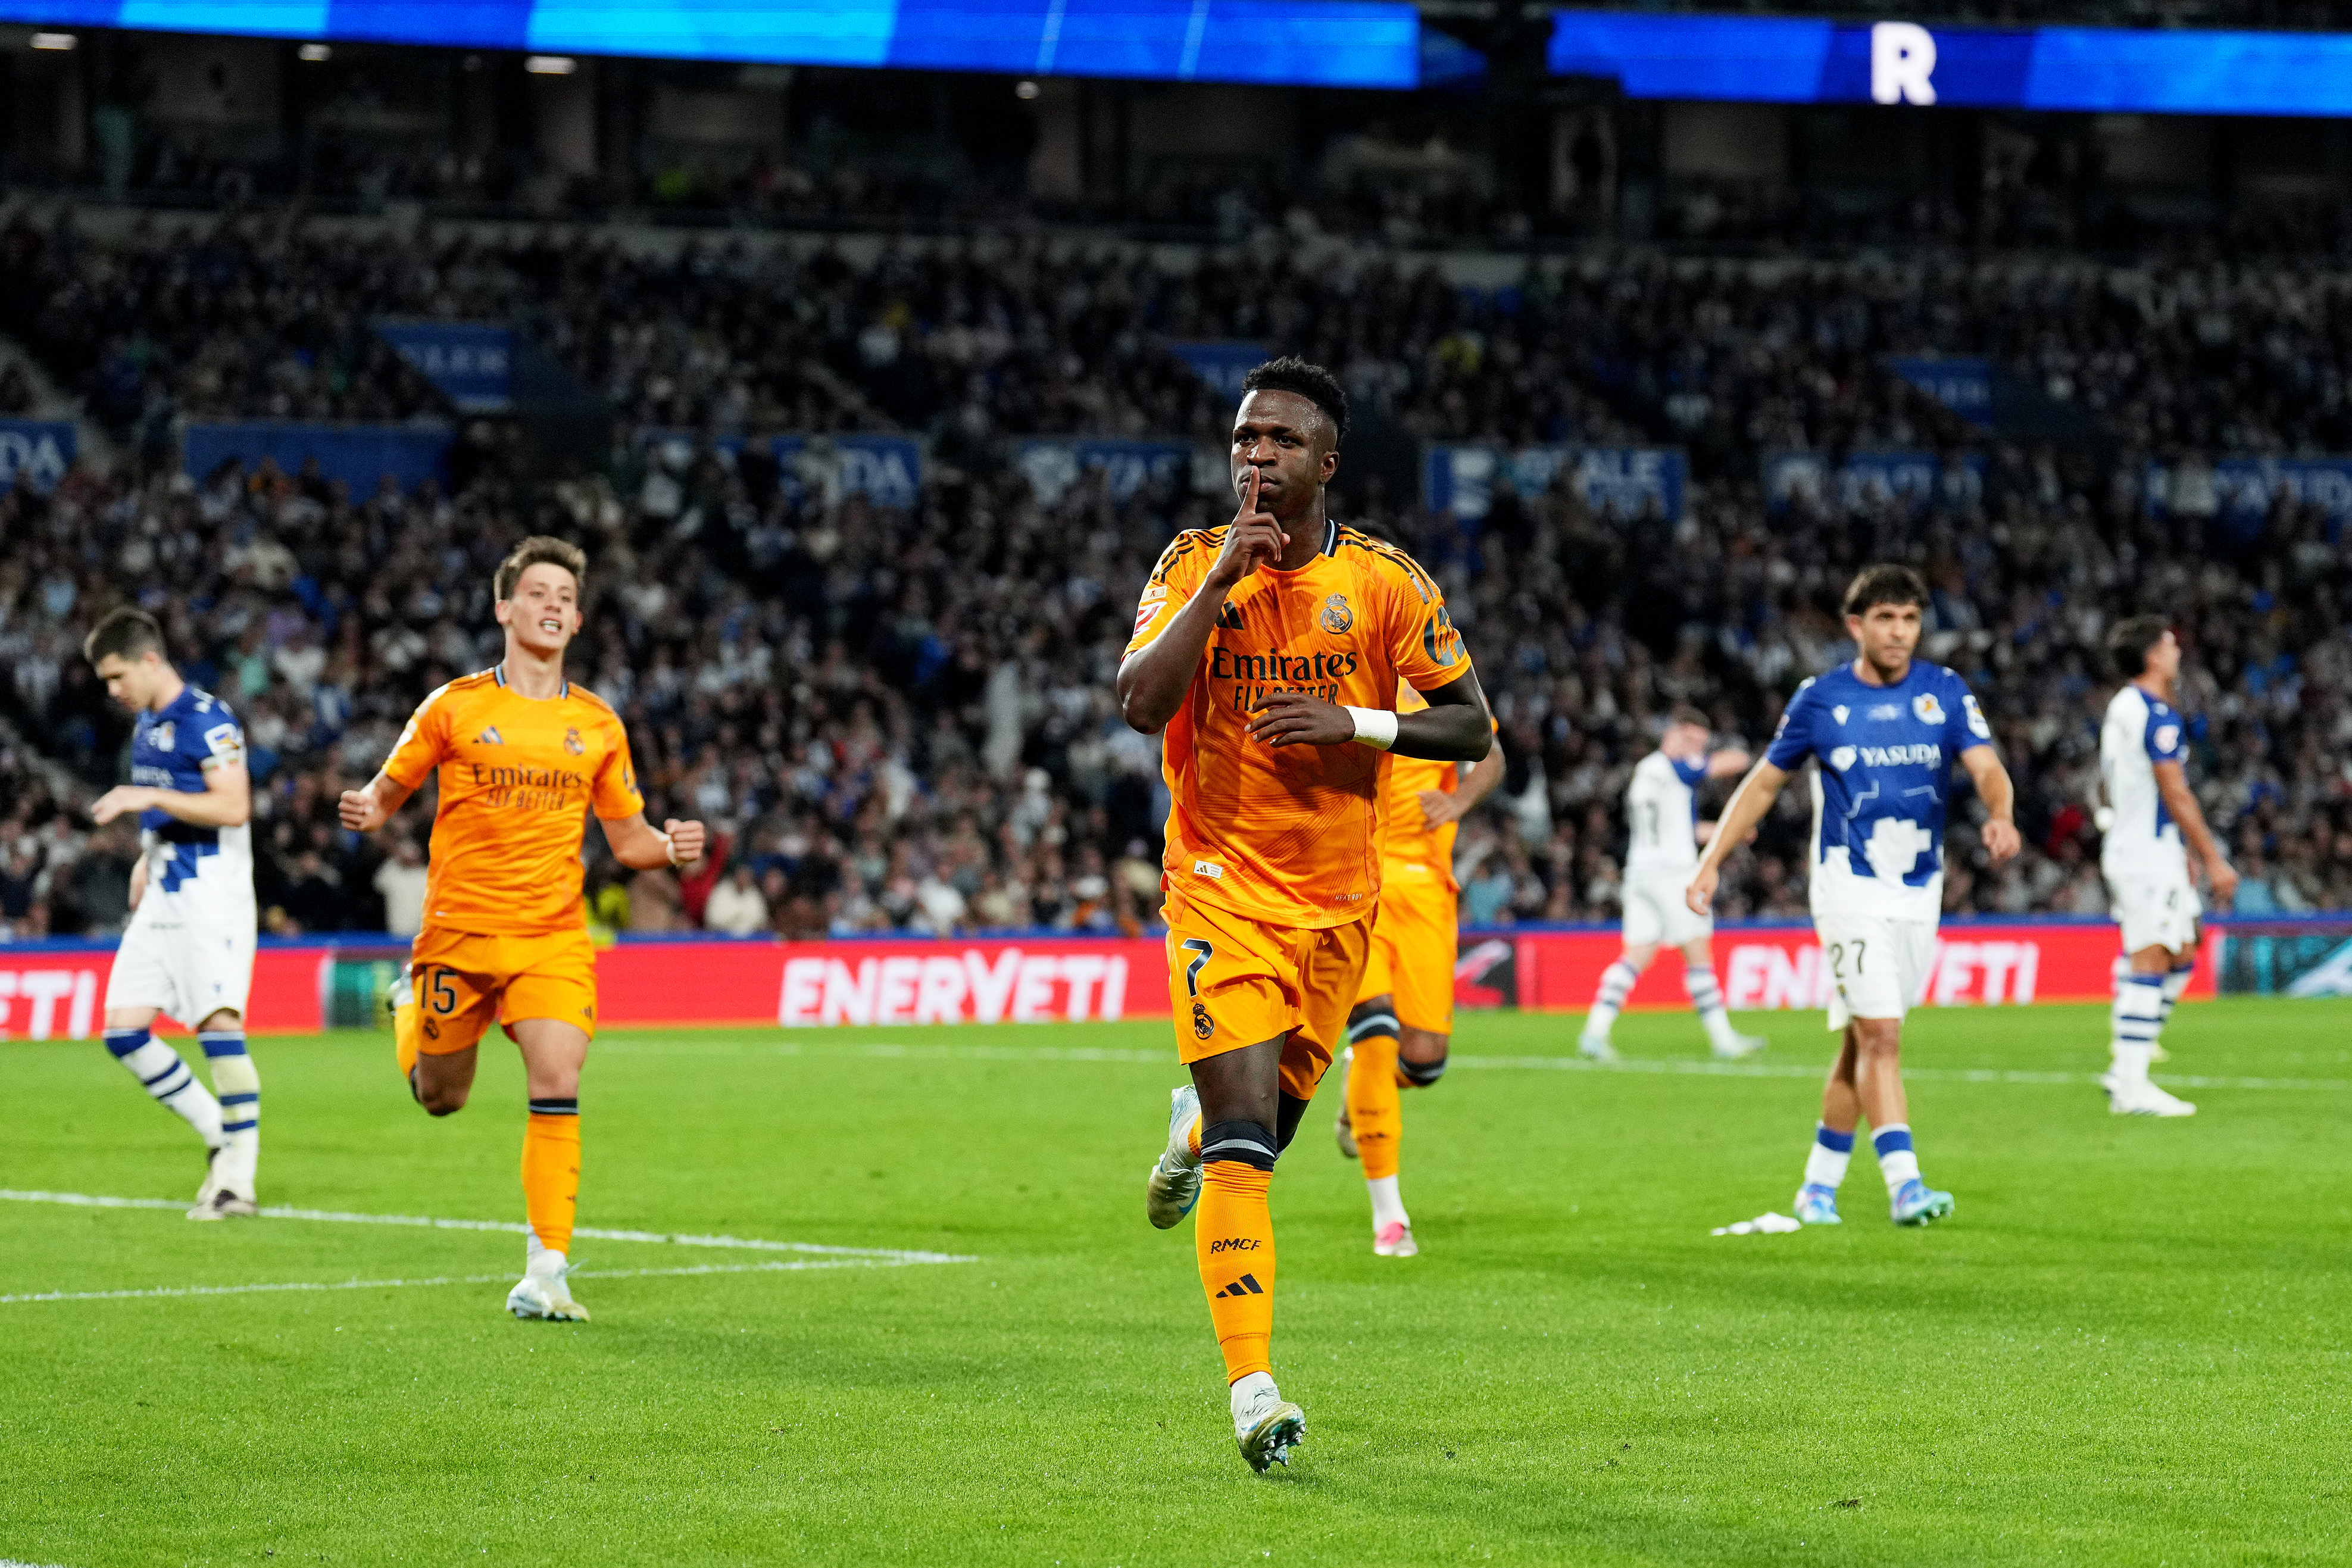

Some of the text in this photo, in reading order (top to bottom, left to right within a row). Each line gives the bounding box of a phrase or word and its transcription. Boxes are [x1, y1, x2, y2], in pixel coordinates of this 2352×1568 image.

[1871, 20, 1938, 106] R
[1212, 646, 1357, 681] Emirates
[1234, 684, 1339, 711] FLY TTER
[1859, 743, 1941, 767] YASUDA
[471, 763, 582, 788] Emirates
[1335, 893, 1363, 901] HEAT.RDY
[1180, 938, 1214, 998] 7
[1725, 938, 2041, 1010] ENETI
[1831, 939, 1867, 978] 27
[420, 965, 457, 1014] 15
[1210, 1238, 1261, 1254] RMCF
